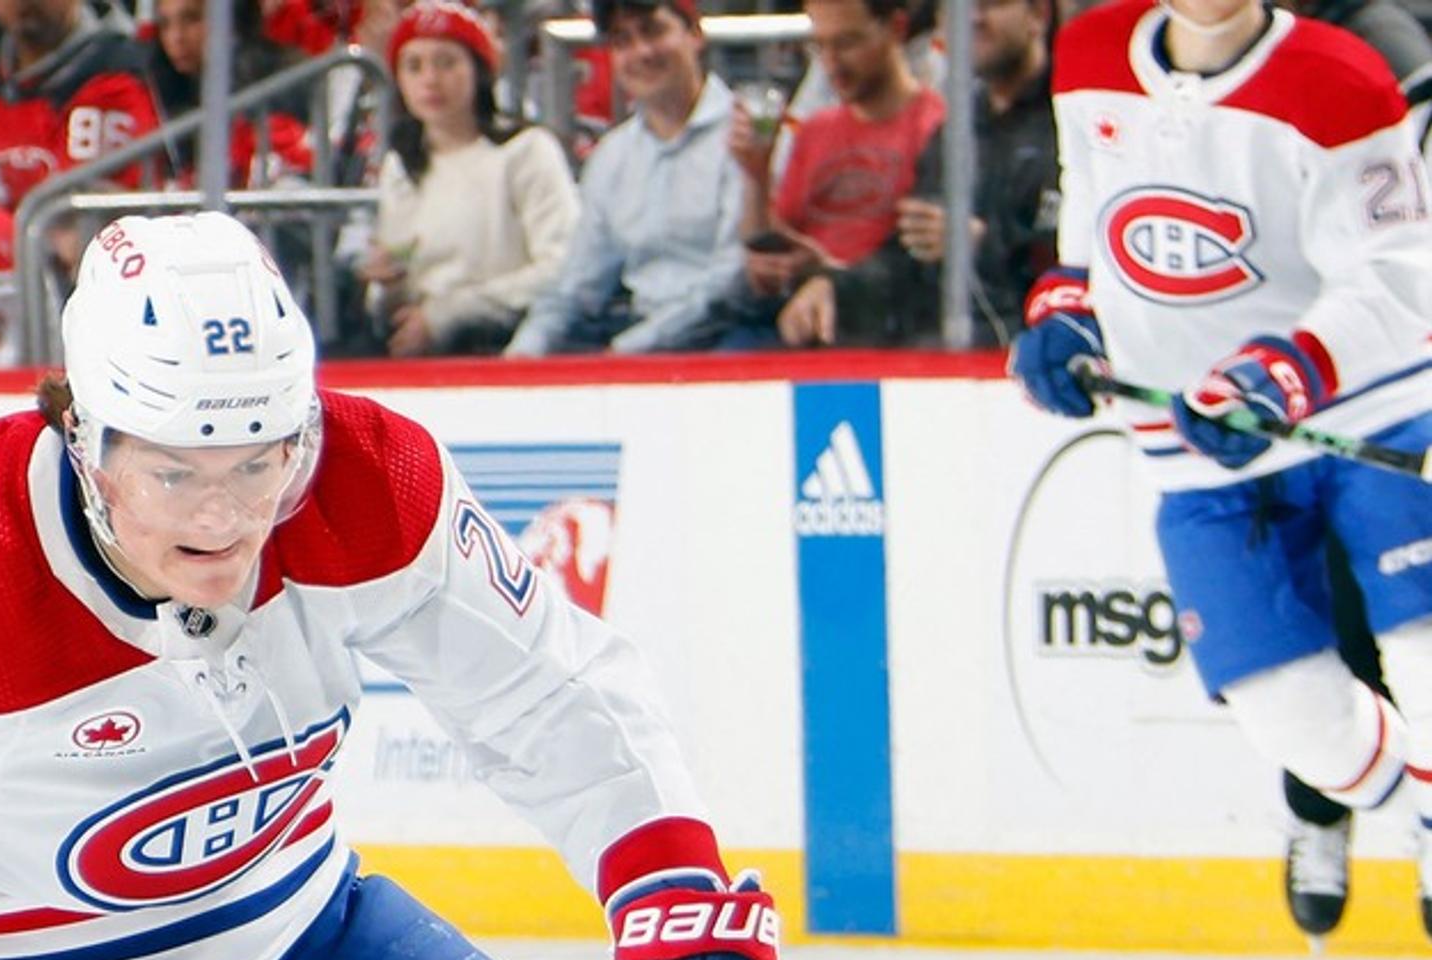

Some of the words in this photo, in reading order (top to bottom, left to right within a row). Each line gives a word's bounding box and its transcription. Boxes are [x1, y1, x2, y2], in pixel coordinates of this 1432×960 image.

[202, 318, 255, 356] 22
[794, 499, 883, 535] adidas
[1043, 591, 1182, 665] msg
